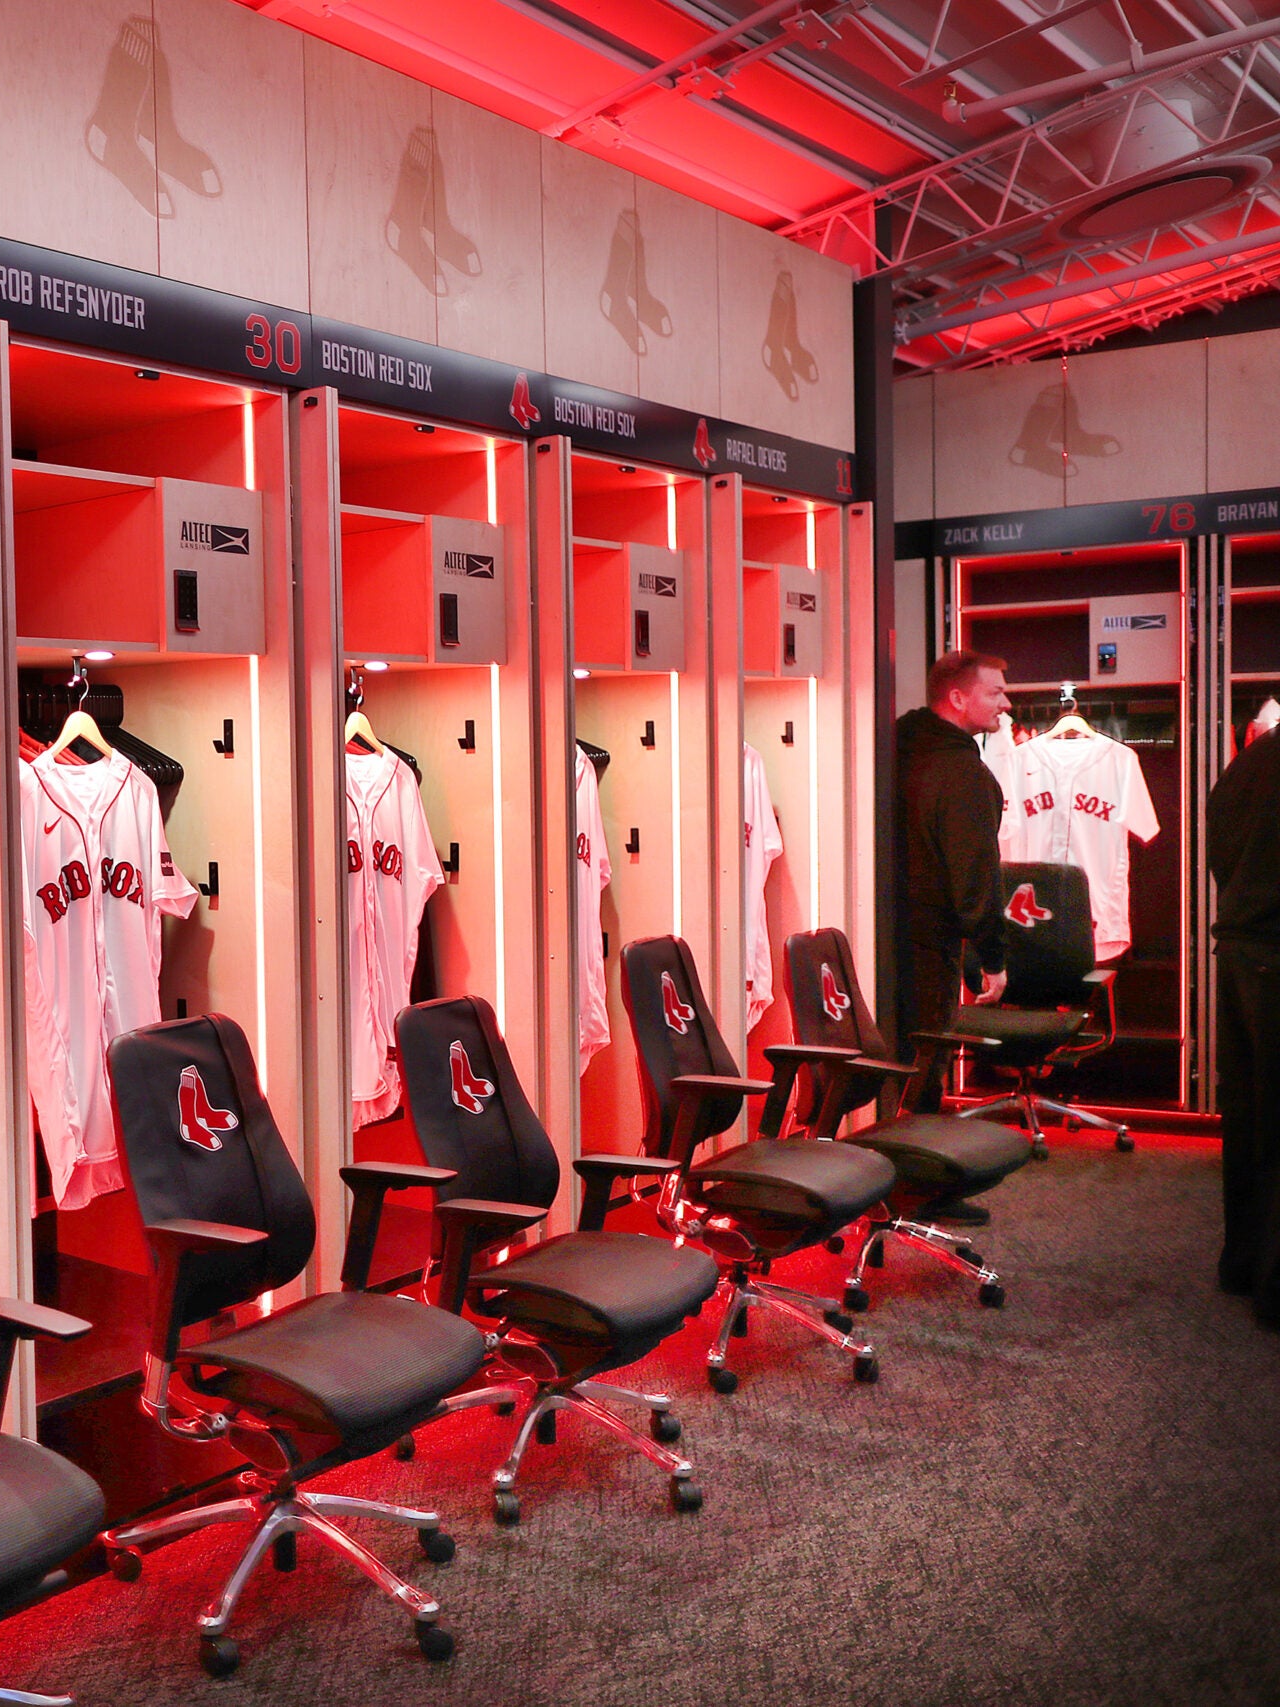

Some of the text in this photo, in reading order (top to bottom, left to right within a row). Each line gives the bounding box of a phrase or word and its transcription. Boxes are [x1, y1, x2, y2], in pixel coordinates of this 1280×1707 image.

[40, 275, 145, 330] REFSNYDER
[245, 313, 301, 375] 30
[321, 340, 432, 392] BOSTON RED SOX
[554, 396, 636, 439] BOSTON RED SOX
[726, 438, 787, 473] RAFAEL DEVERS
[836, 458, 853, 494] 11
[1141, 503, 1196, 534] 76
[1217, 500, 1278, 522] BRAYAN
[181, 521, 210, 544] ALTEC
[944, 523, 1024, 545] ZACK KELLY
[444, 551, 466, 570] ALTEC
[1074, 793, 1116, 822] SOX
[101, 857, 145, 909] SOX
